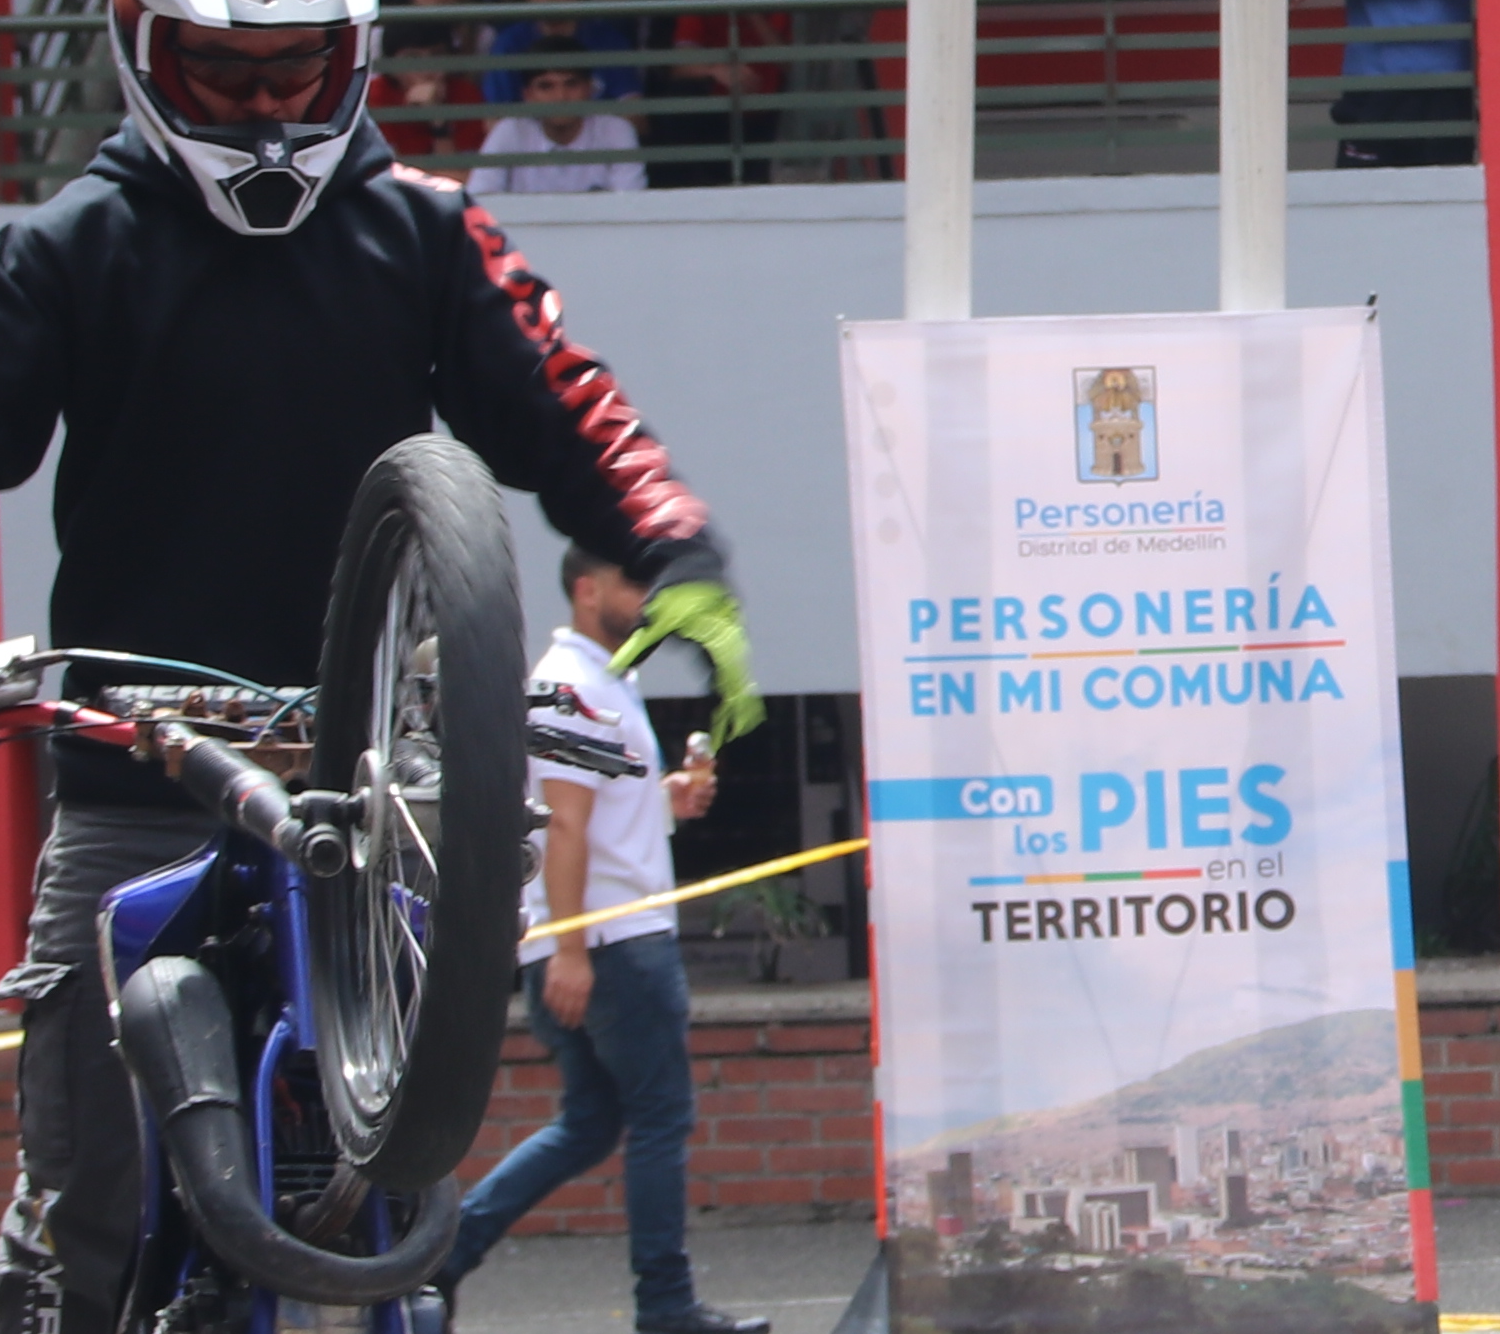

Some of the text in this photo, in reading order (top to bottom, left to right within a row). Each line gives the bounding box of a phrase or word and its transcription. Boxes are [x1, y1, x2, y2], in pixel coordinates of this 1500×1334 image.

[1015, 490, 1225, 529] Personería
[1017, 534, 1226, 557] Distrital de Medellín
[909, 572, 1337, 643] PERSONERÍA
[910, 658, 1345, 716] EN MI COMUNA
[960, 763, 1292, 852] Con PIES
[1014, 824, 1068, 855] los
[1207, 851, 1284, 880] en el
[972, 889, 1296, 942] TERRITORIO
